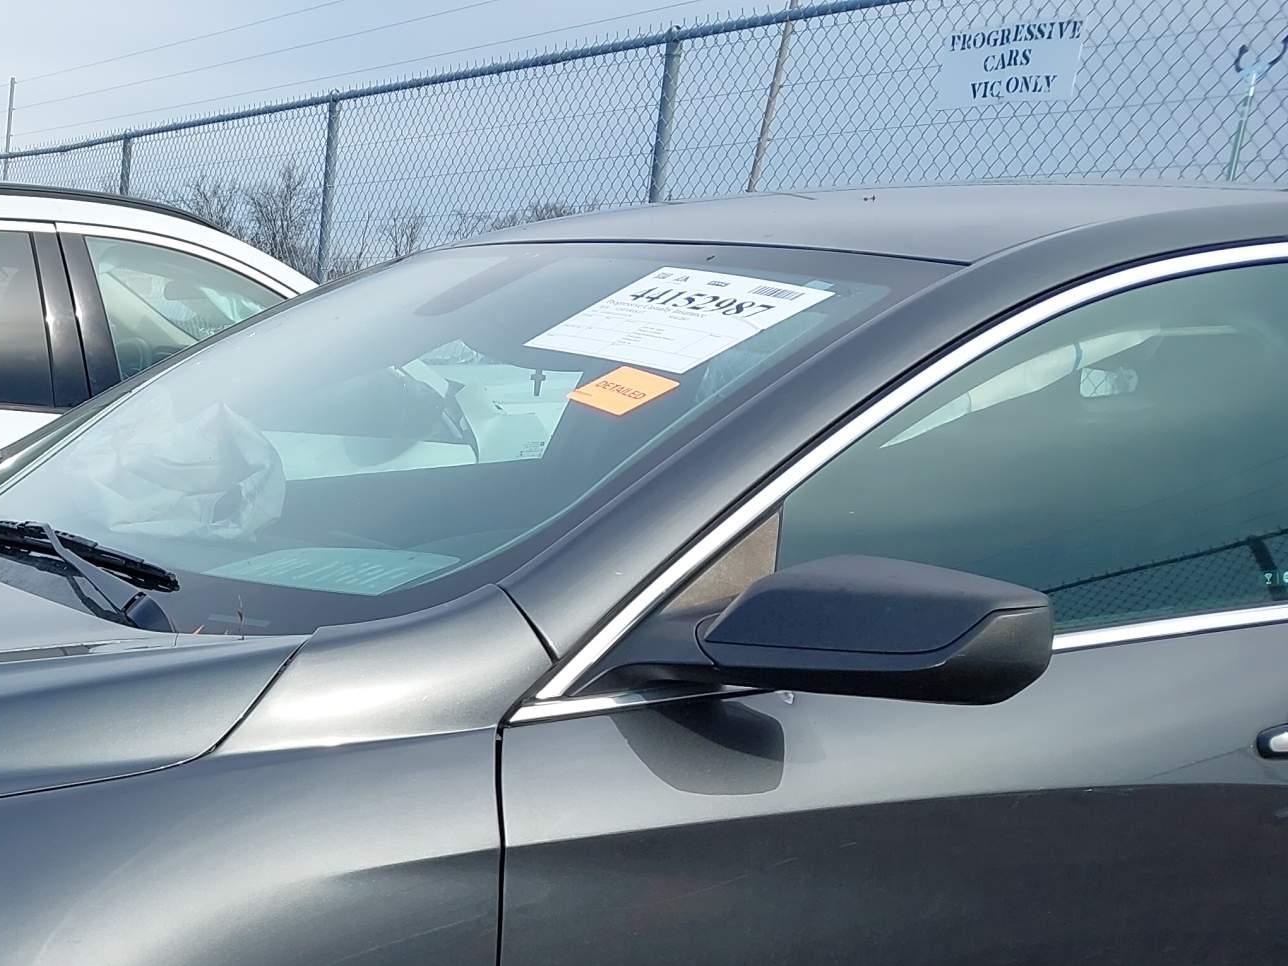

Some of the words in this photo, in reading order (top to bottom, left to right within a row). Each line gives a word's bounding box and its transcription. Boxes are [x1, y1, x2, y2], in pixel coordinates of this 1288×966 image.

[950, 20, 1083, 51] PROGRESSIVE
[983, 49, 1032, 72] CARS
[970, 80, 1002, 99] VIC
[1005, 75, 1057, 93] ONLY
[629, 286, 776, 318] 44152987
[596, 380, 647, 399] DETAILED
